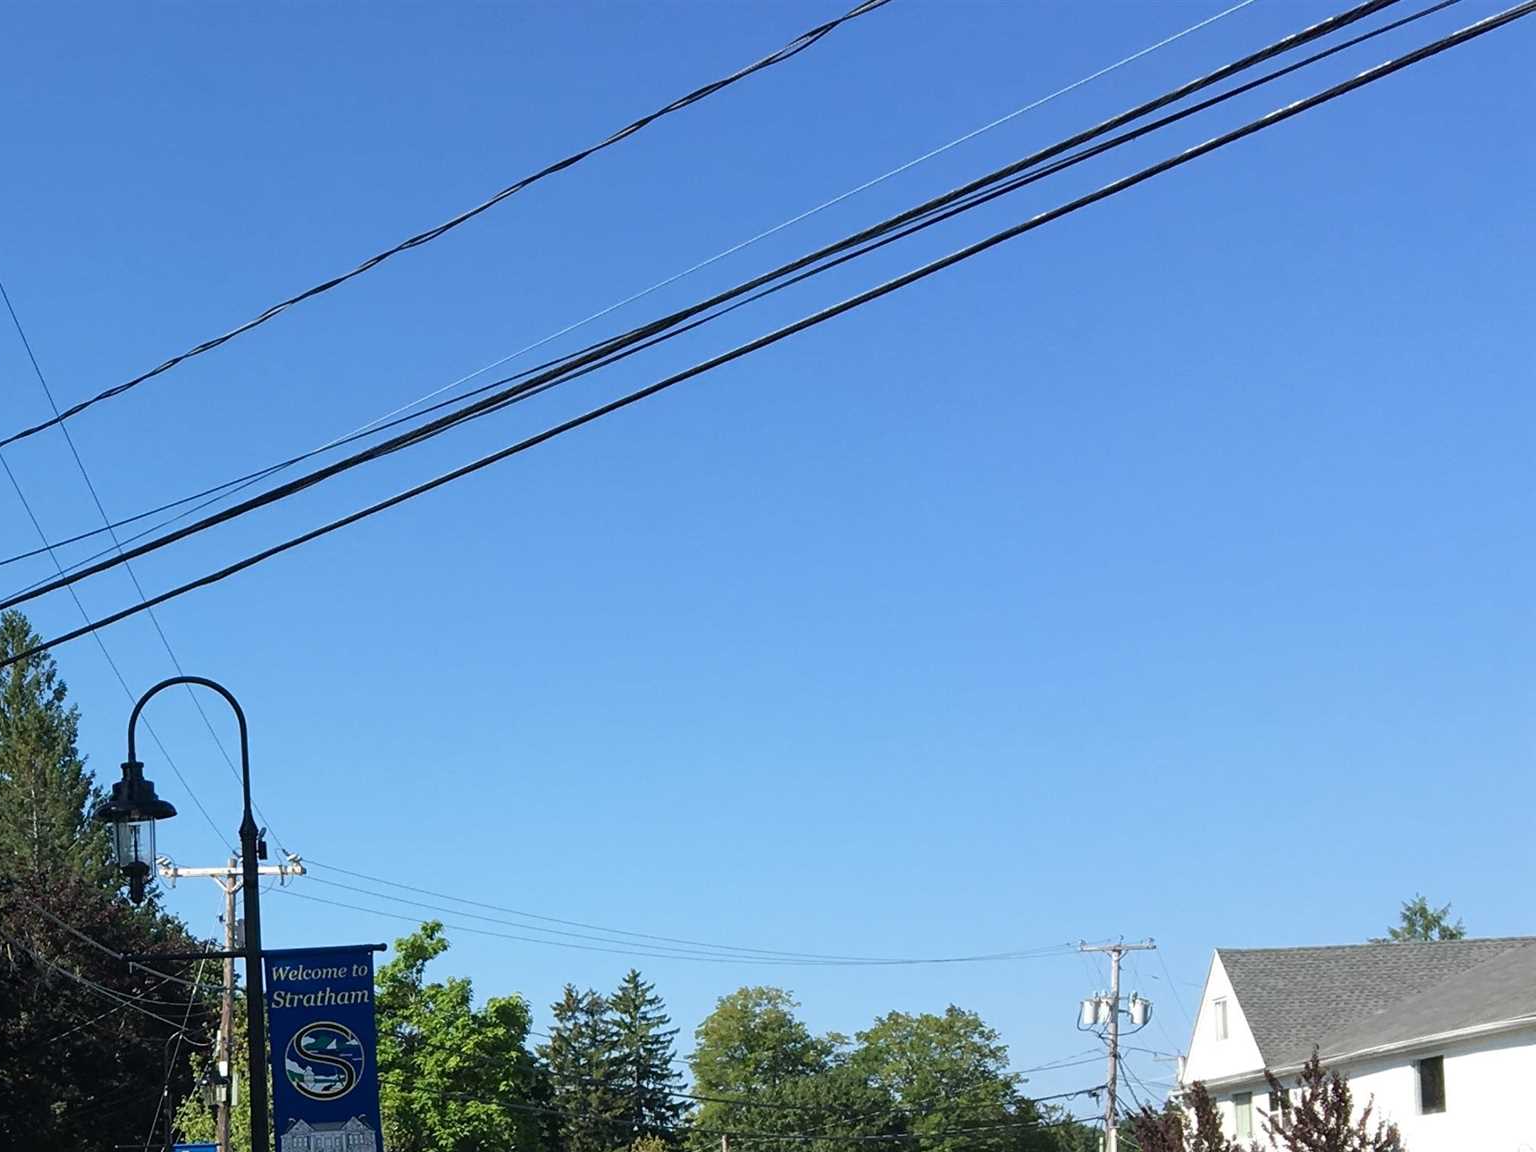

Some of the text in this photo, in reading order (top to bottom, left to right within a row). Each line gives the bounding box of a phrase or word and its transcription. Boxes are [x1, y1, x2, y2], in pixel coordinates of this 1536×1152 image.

[272, 964, 368, 981] Welcome to
[271, 987, 369, 1009] Stratham
